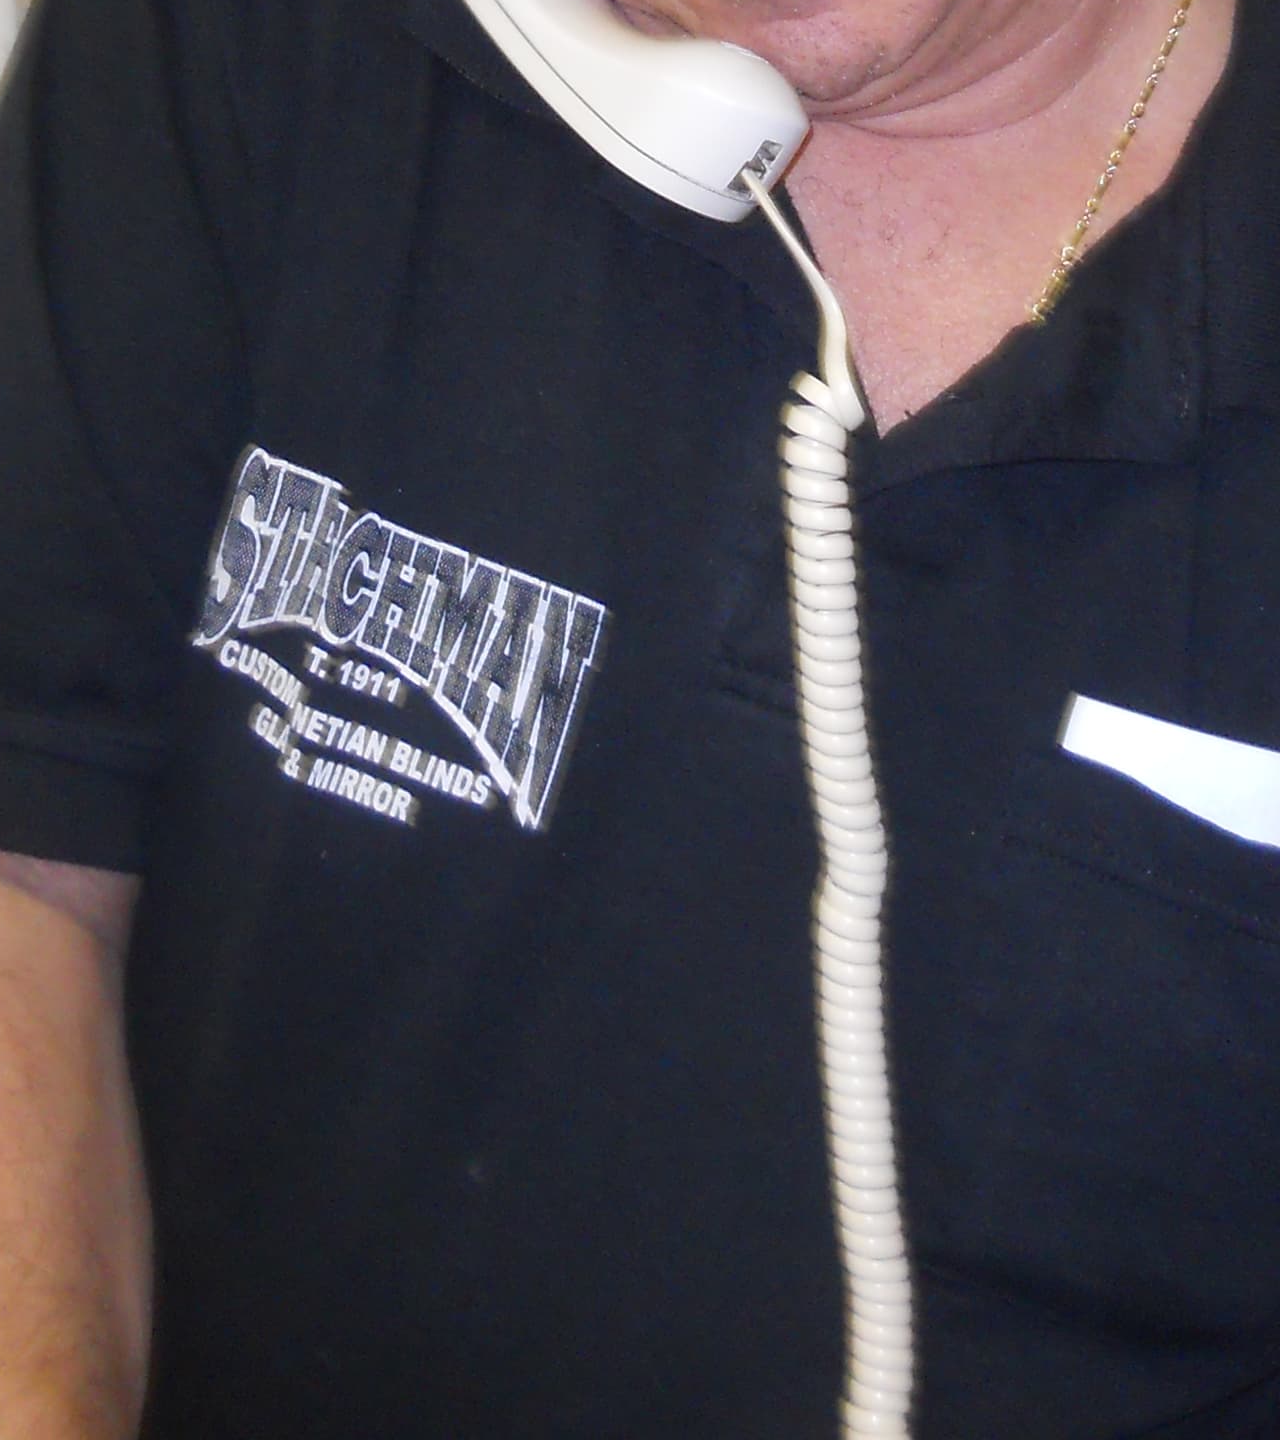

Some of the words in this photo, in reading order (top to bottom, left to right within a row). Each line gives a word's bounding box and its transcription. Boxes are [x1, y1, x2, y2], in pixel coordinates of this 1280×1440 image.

[220, 639, 304, 709] CUSTOM
[339, 659, 402, 704] 1911
[255, 706, 292, 756] GLA
[290, 702, 390, 767] NETIAN
[389, 743, 492, 807] BLINDS
[283, 748, 302, 779] &
[307, 759, 413, 823] MIRROR
